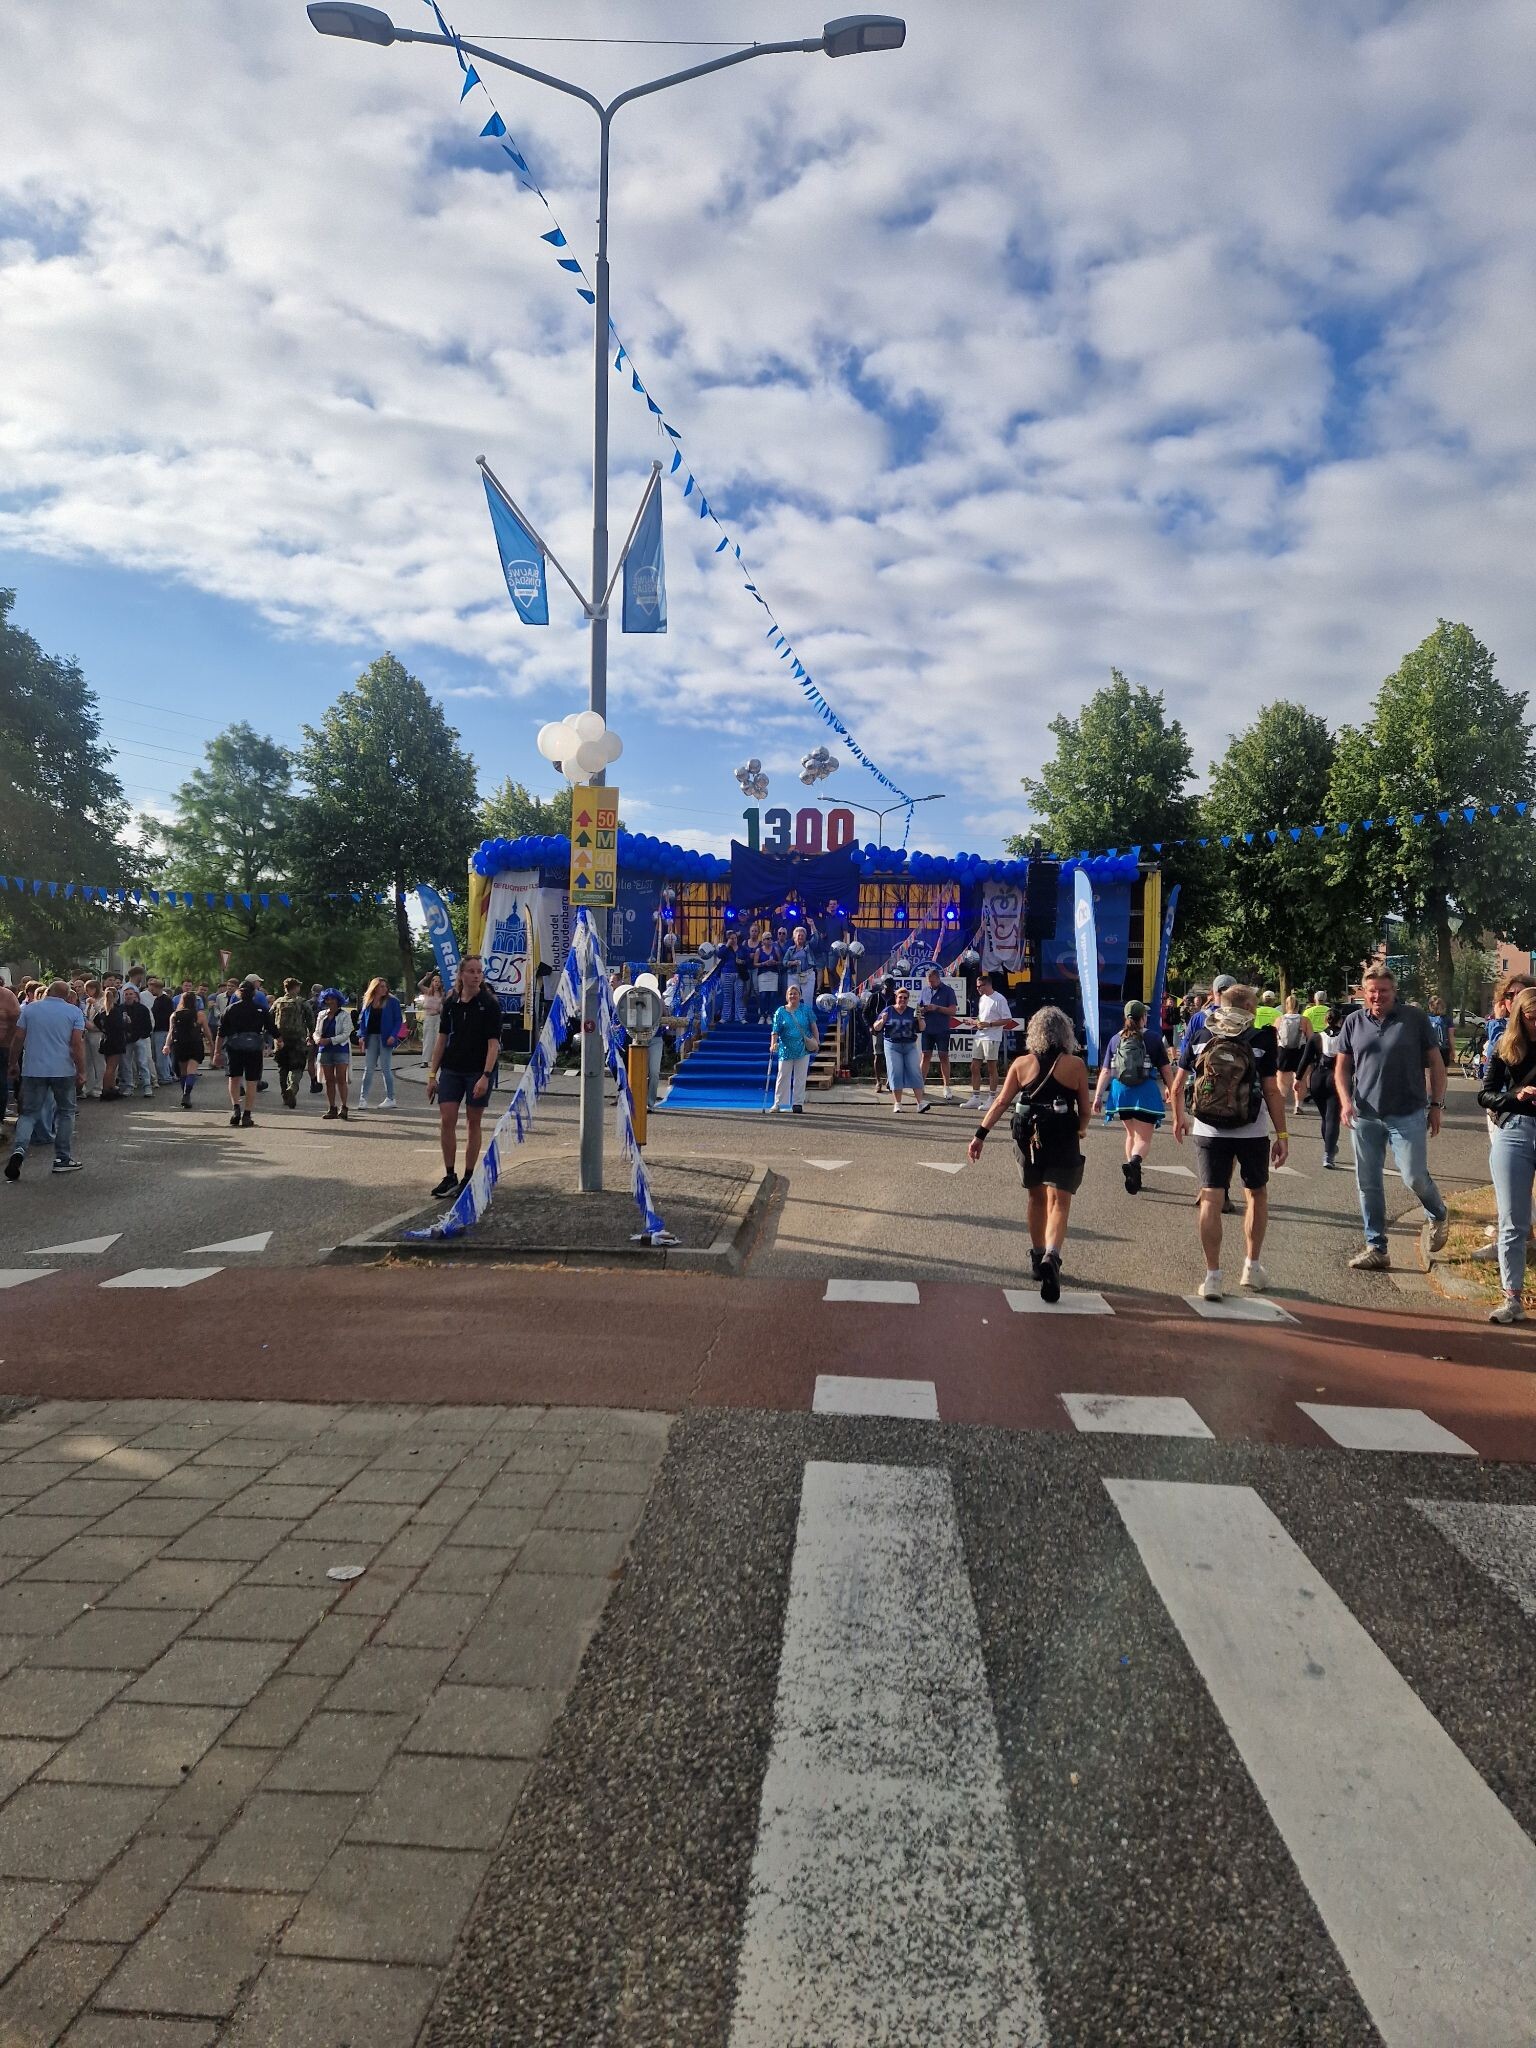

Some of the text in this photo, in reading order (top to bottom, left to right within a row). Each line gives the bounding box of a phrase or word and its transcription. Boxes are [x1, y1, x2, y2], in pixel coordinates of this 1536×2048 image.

[597, 811, 615, 827] 50
[597, 831, 614, 848] M
[742, 808, 855, 854] 1300
[597, 853, 613, 868] 40
[595, 873, 613, 889] 30
[560, 895, 570, 959] Woudenberg
[549, 914, 561, 972] Houthandel
